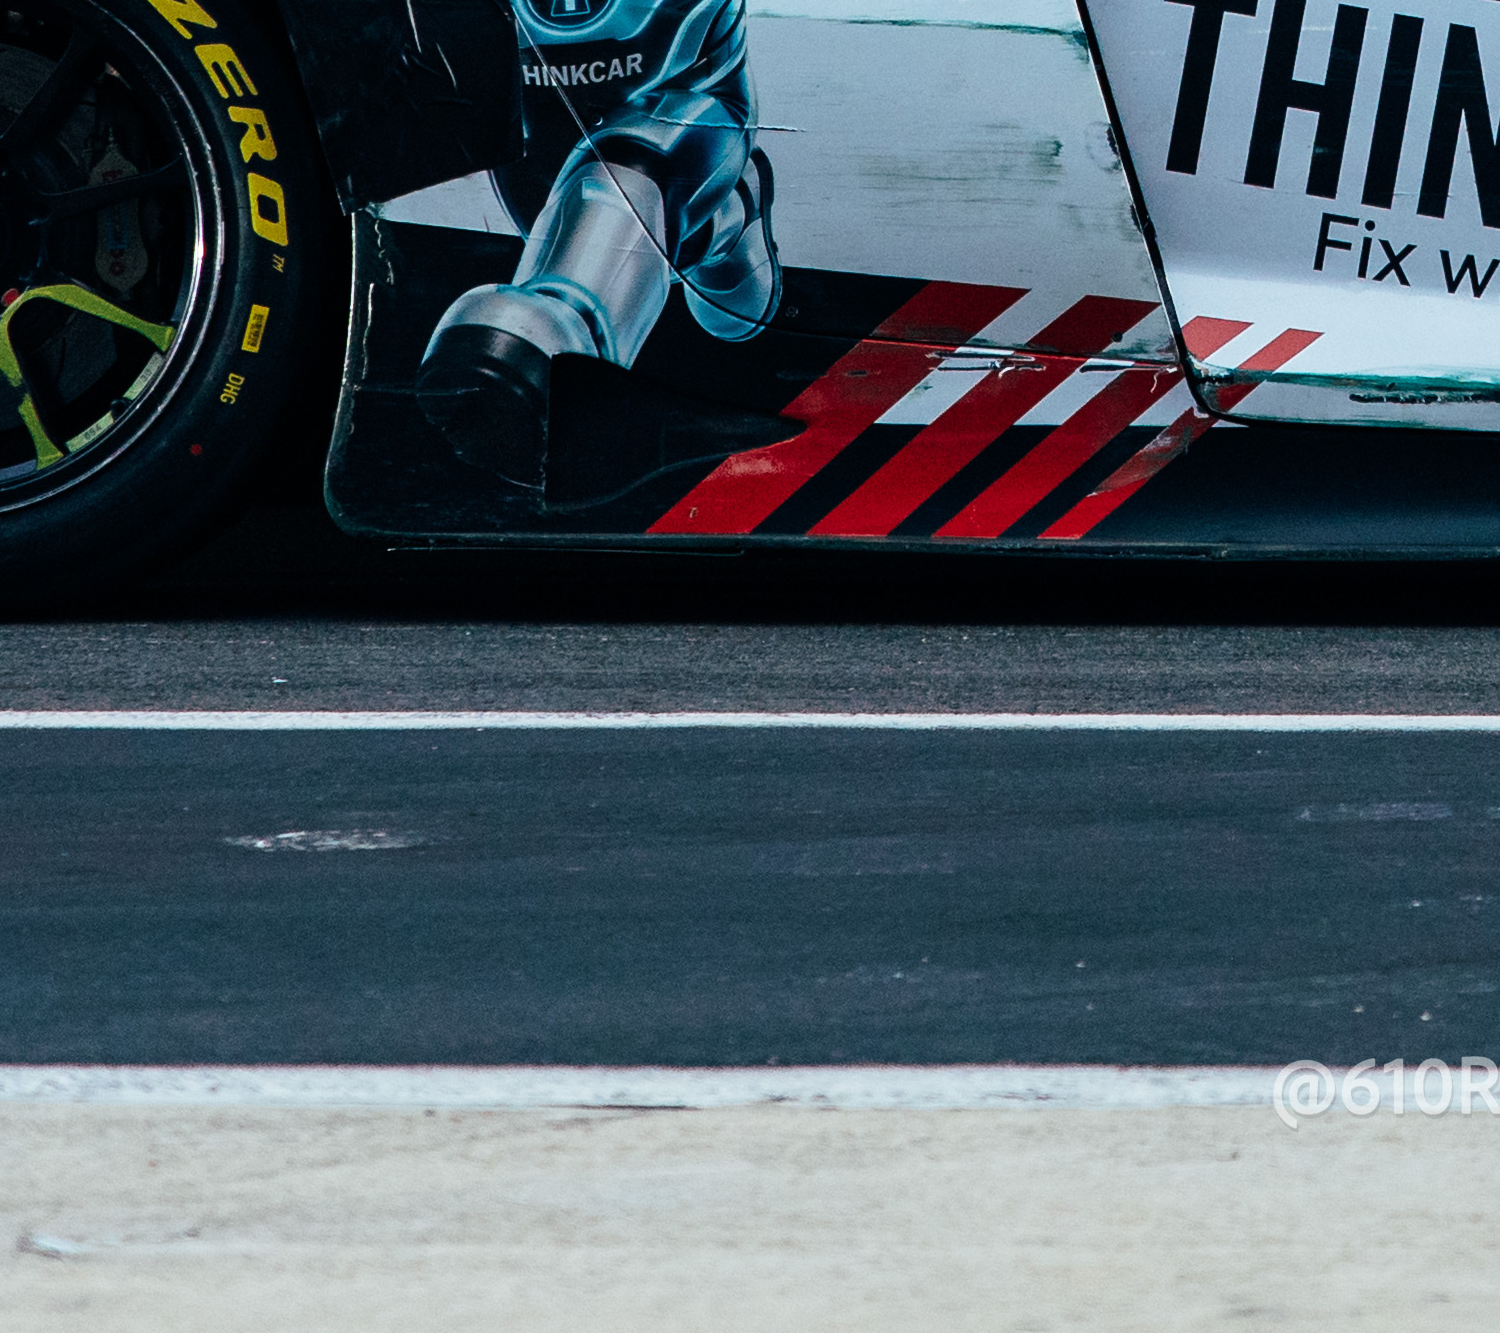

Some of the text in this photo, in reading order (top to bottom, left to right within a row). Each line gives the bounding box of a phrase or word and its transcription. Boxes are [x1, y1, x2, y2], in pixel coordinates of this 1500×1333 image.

[521, 52, 644, 87] HINKCAR
[1313, 212, 1412, 288] Fix
[219, 372, 246, 405] DHG
